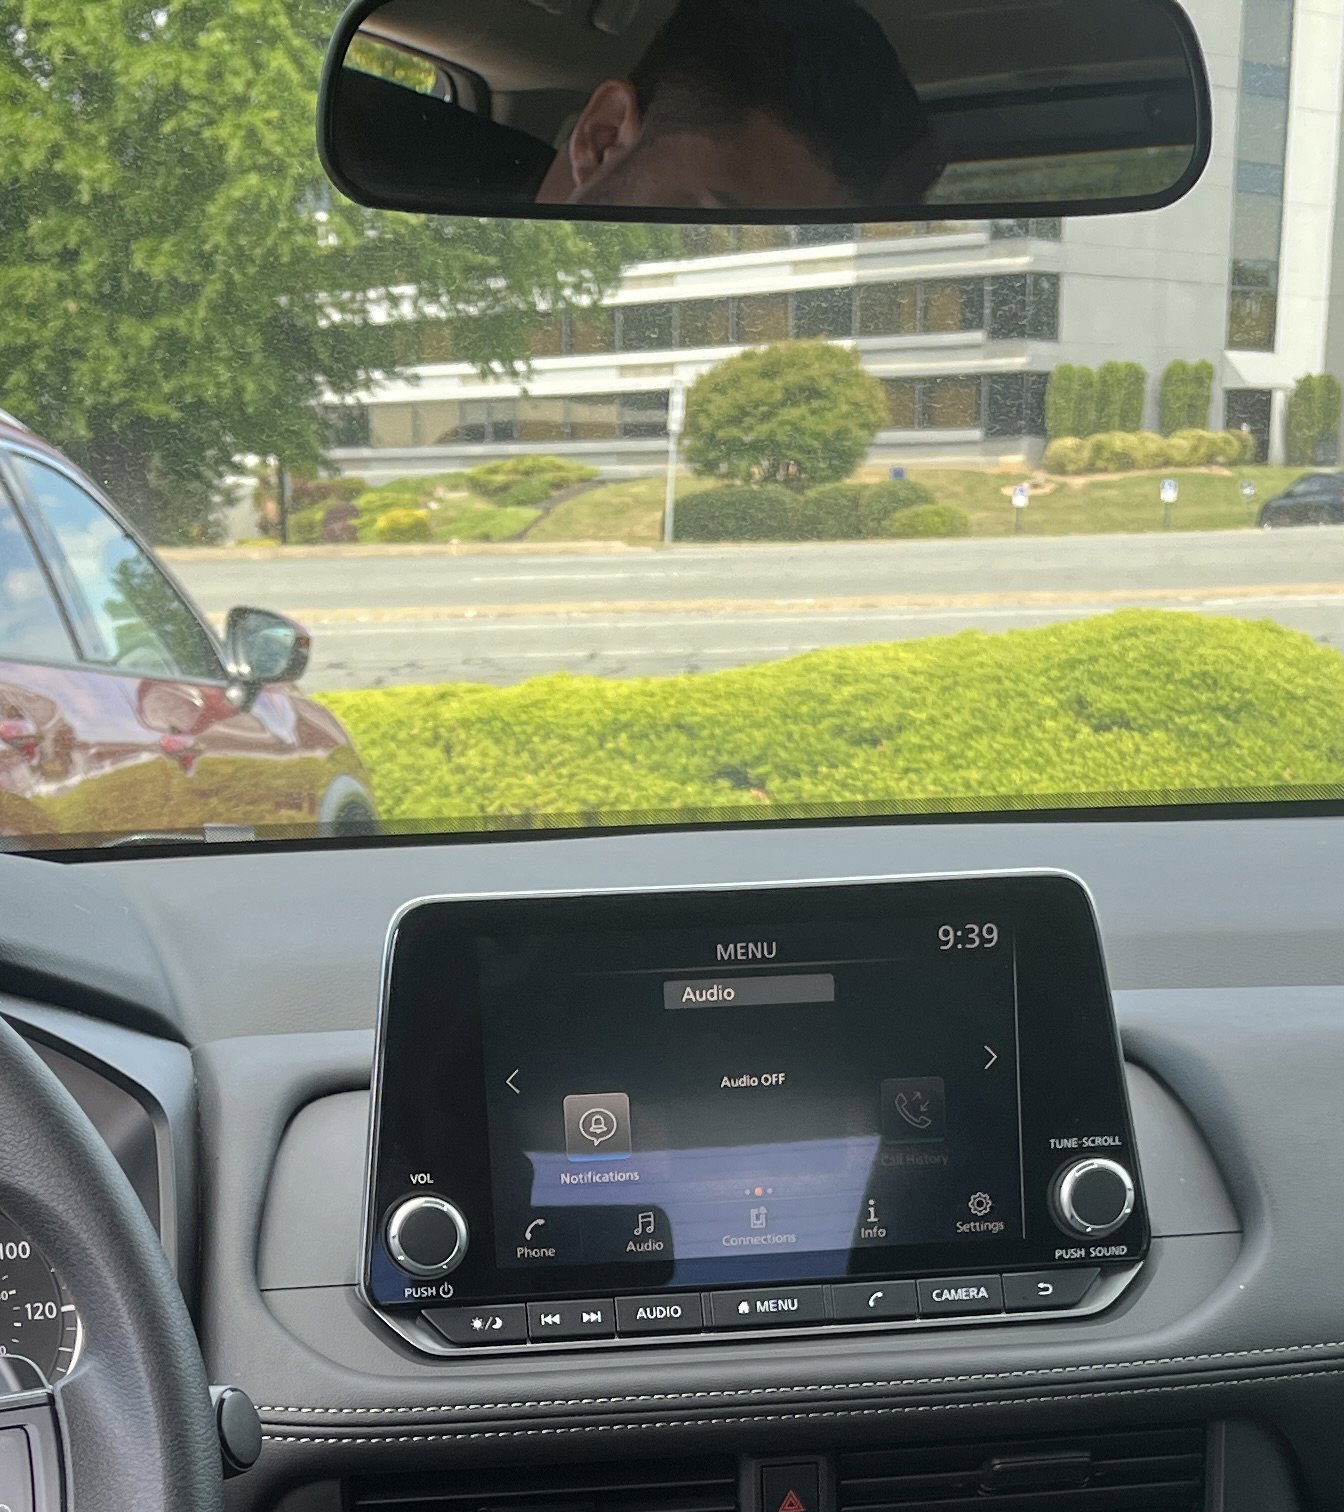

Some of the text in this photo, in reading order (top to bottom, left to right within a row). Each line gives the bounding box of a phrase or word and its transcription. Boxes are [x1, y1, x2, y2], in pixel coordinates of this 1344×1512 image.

[938, 923, 998, 950] 9:39
[716, 941, 777, 961] MENU
[681, 985, 736, 1003] Audio
[720, 1072, 786, 1089] Audio OFF
[910, 1152, 949, 1167] History
[410, 1173, 434, 1185] VOL
[560, 1169, 640, 1185] Notifications
[860, 1226, 886, 1238] Info
[956, 1220, 1004, 1234] Settings
[626, 1238, 664, 1252] Audio
[722, 1232, 796, 1246] Connections
[516, 1245, 556, 1259] Phone
[1055, 1244, 1127, 1260] PUSH SOUND
[404, 1286, 436, 1298] PUSH
[932, 1286, 988, 1302] CAMERA
[25, 1302, 57, 1320] 120
[636, 1305, 682, 1319] AUDIO
[756, 1298, 798, 1313] MENU
